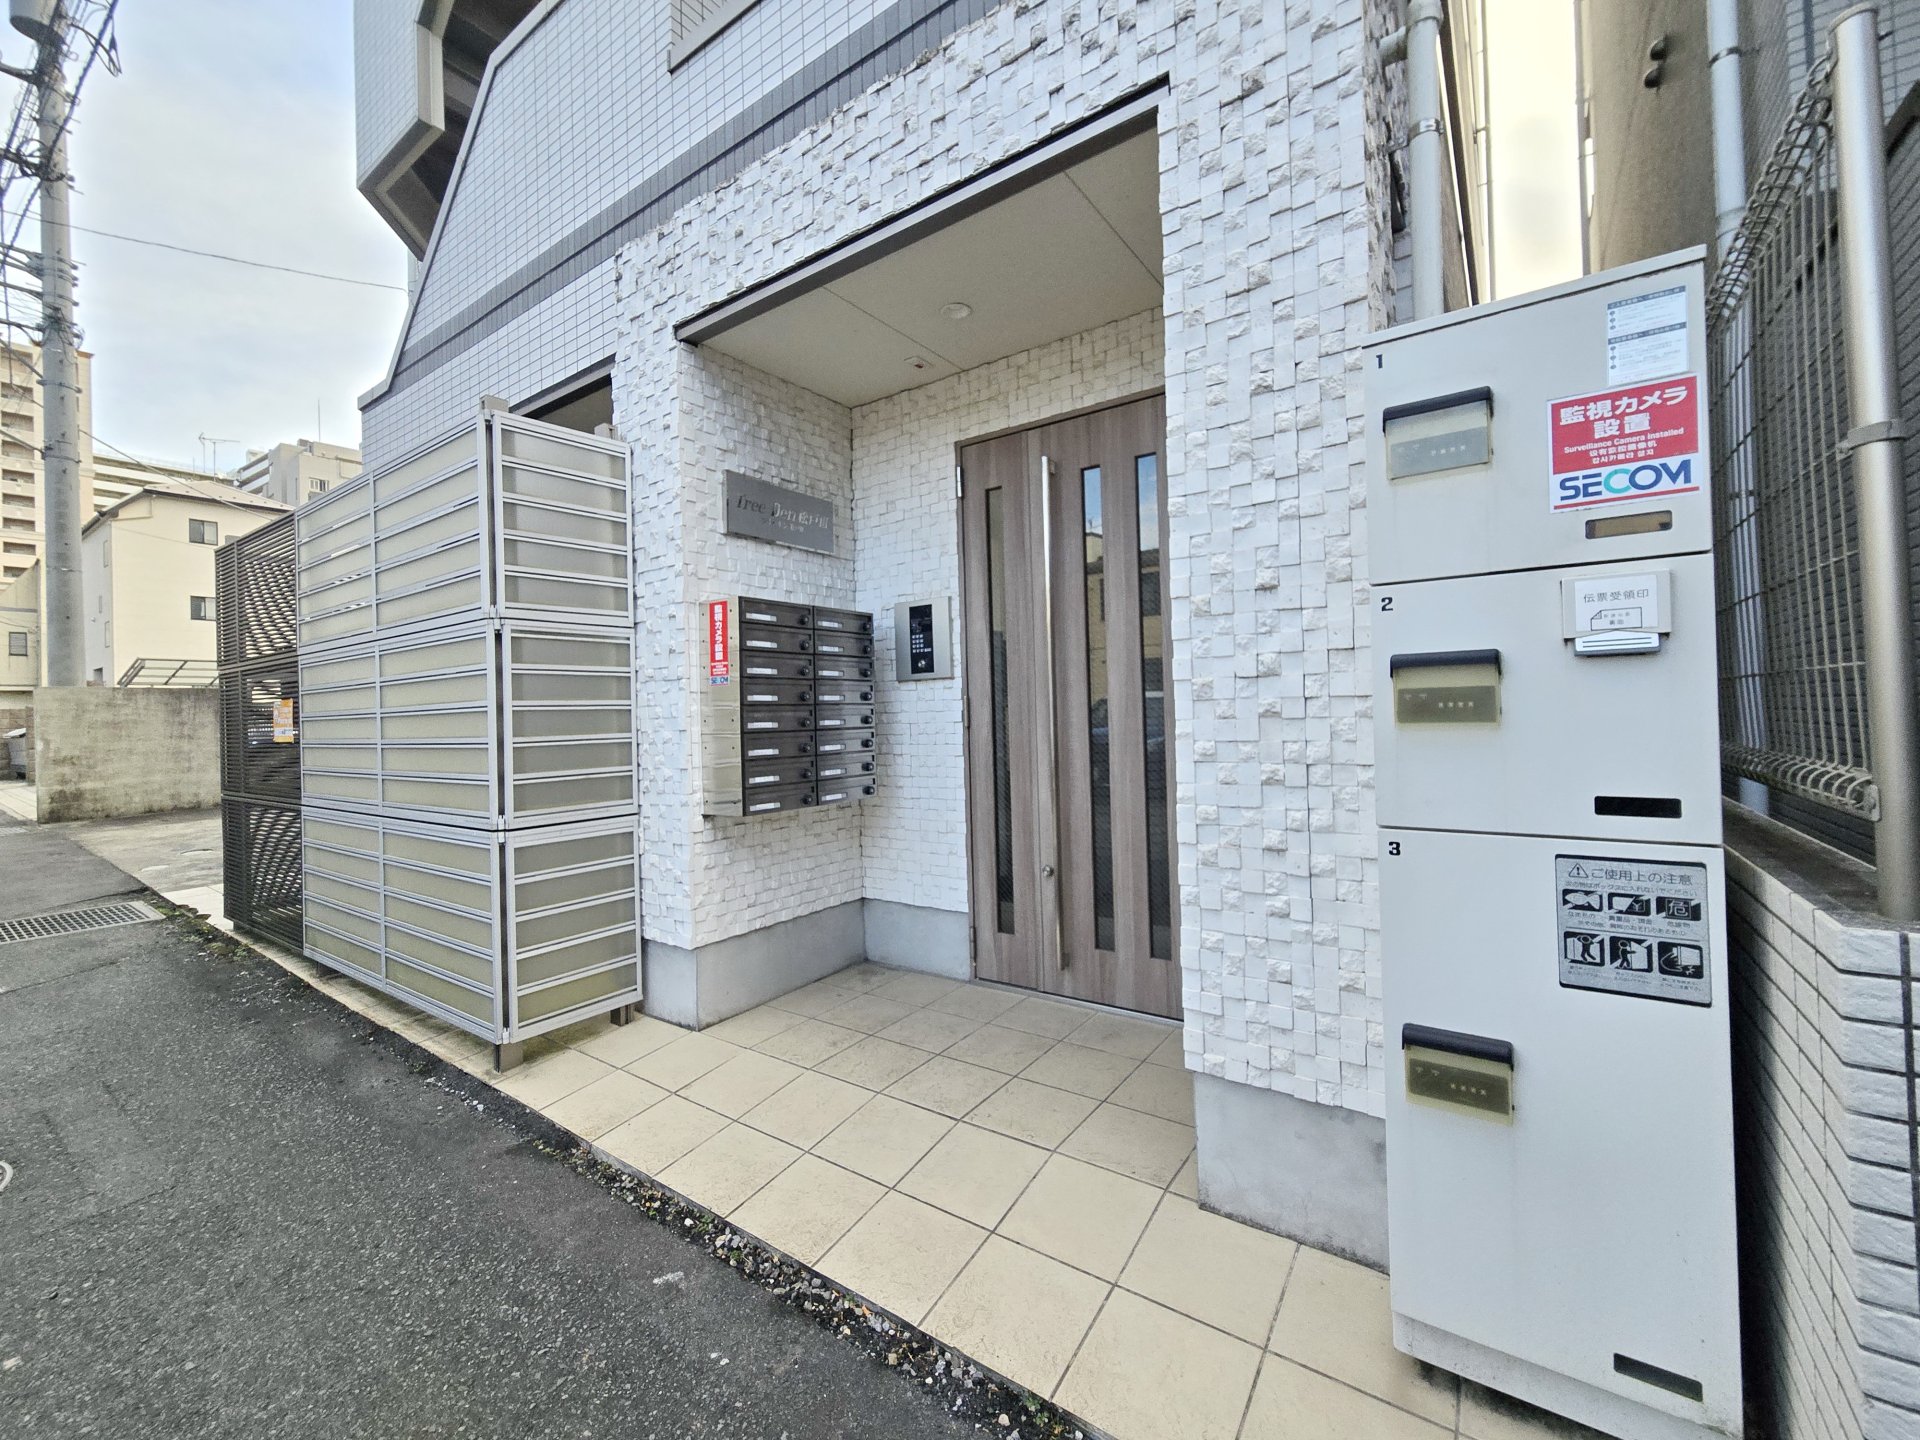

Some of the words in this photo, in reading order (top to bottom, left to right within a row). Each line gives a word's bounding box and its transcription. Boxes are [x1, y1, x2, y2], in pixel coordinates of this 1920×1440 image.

[1376, 354, 1383, 369] 1
[1560, 386, 1688, 425] 監視カメラ
[1594, 412, 1650, 439] 設置
[1564, 441, 1613, 454] Surveillance
[1614, 434, 1645, 446] Camera
[1647, 427, 1685, 440] Installed
[1559, 459, 1692, 501] SECOM
[1381, 597, 1394, 612] 2
[1583, 588, 1649, 604] 伝票受領印
[1388, 841, 1401, 855] 3
[1591, 867, 1693, 885] ご使用上の注意
[1669, 900, 1689, 917] 危
